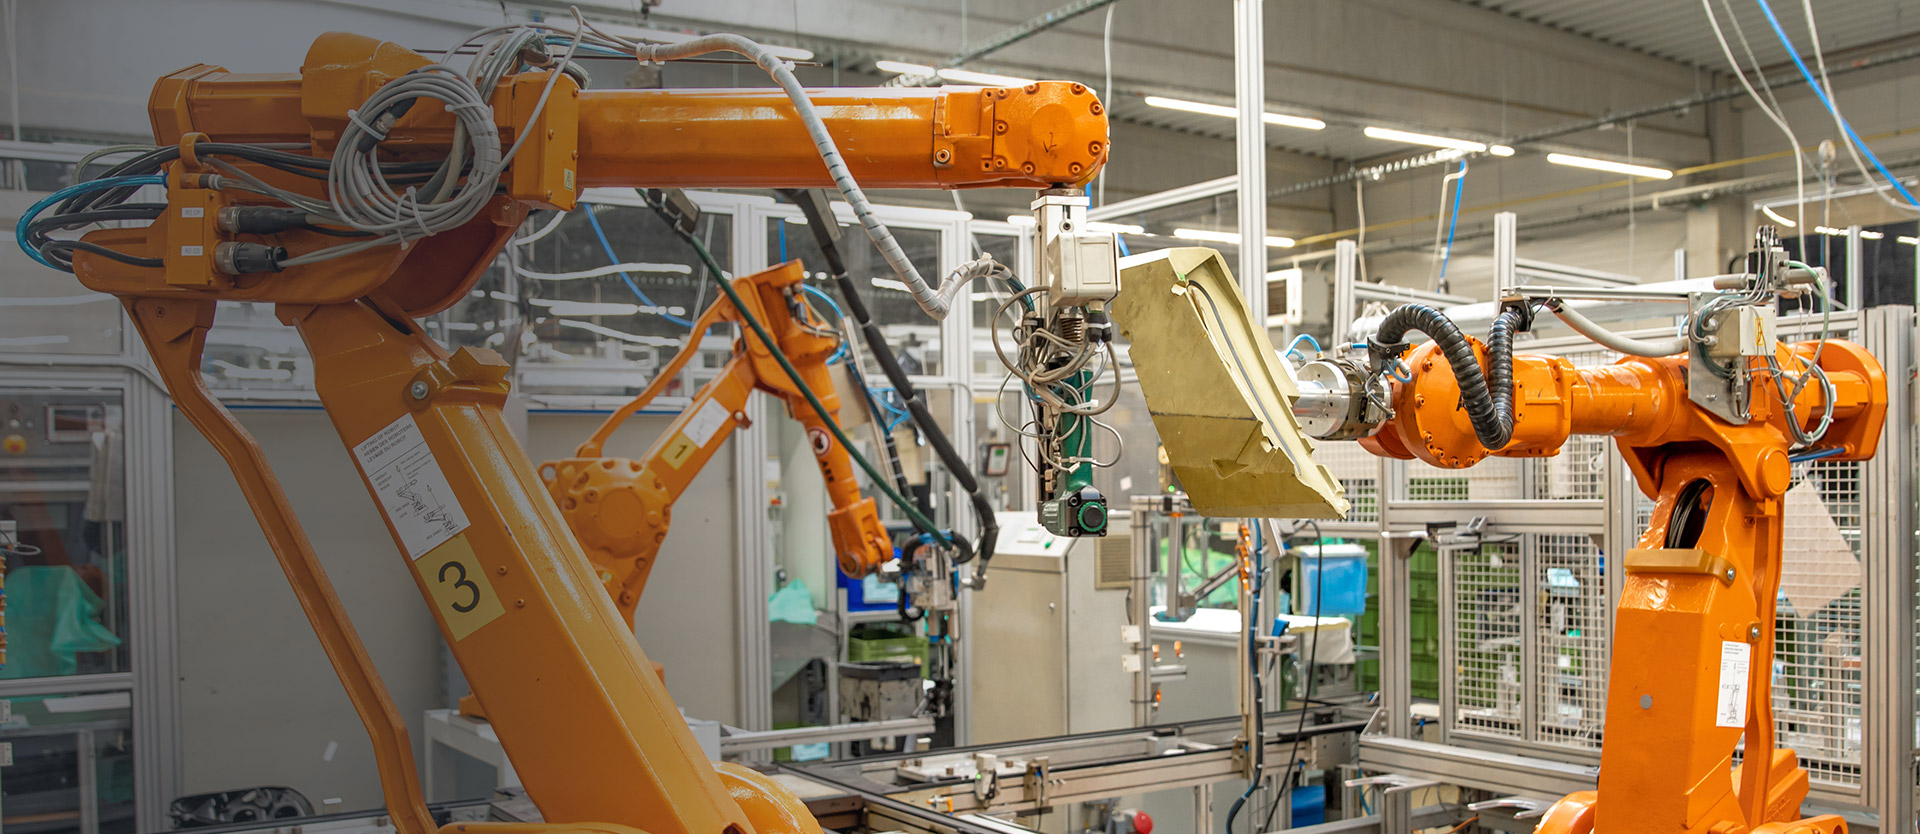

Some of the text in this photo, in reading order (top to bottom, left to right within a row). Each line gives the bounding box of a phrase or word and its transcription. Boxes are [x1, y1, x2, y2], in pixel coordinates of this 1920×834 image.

[360, 438, 378, 452] LIFTING
[384, 424, 400, 436] ROBOT
[363, 423, 413, 457] HEBEN DES ROBOTERS
[367, 450, 384, 463] LEVAGE
[391, 435, 407, 447] ROBOT
[674, 444, 688, 460] 1
[820, 460, 835, 483] ABB
[437, 561, 481, 613] 3
